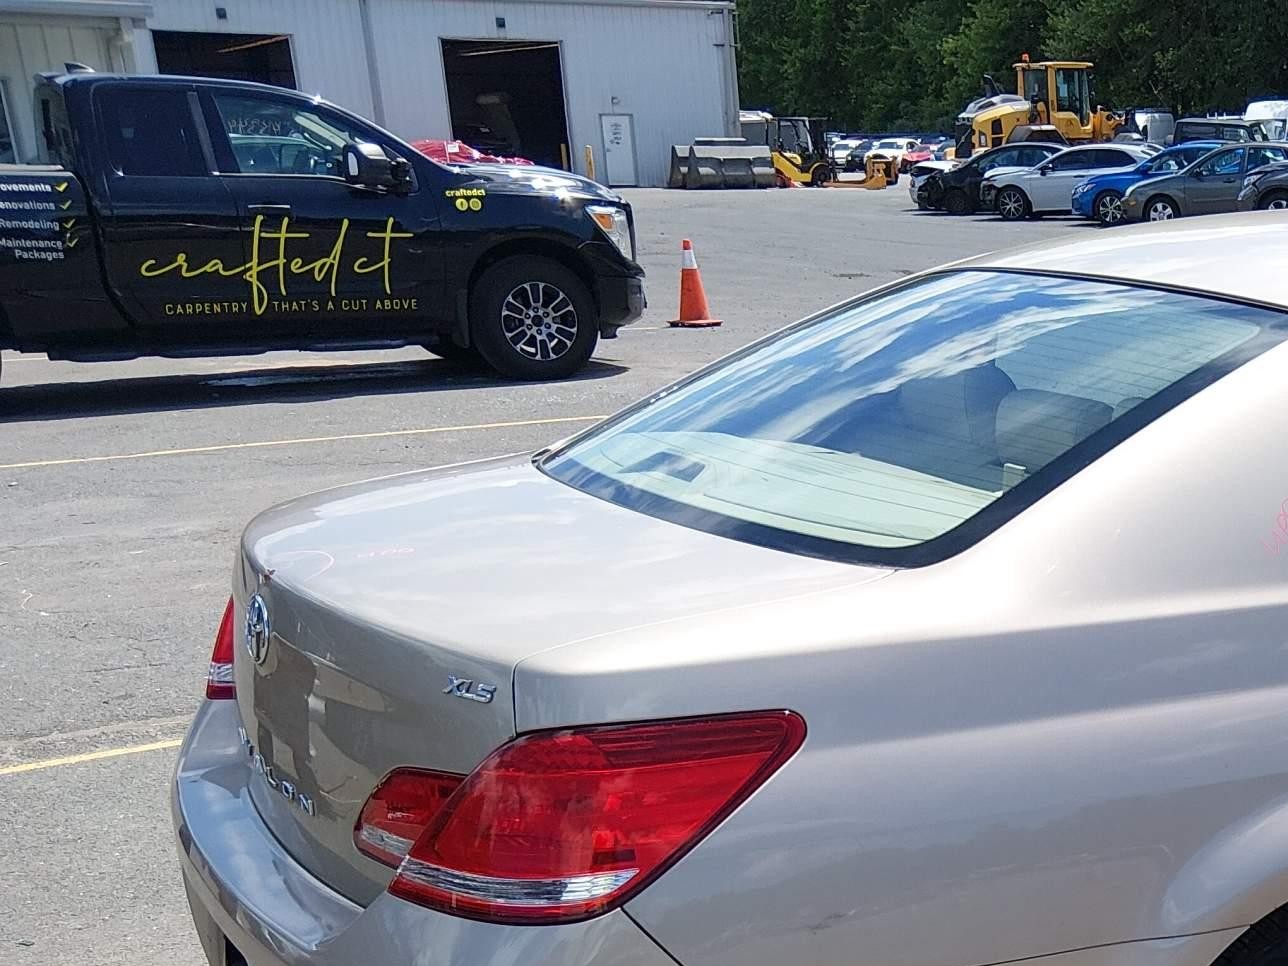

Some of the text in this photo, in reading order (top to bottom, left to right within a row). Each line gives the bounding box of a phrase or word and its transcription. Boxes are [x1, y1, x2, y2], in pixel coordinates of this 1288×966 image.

[0, 183, 52, 192] ovements
[15, 249, 65, 261] Packages
[165, 299, 418, 315] CARPENTRY THAT'S A CUT ABOVE
[442, 674, 497, 704] XLS
[238, 726, 317, 817] AALON
